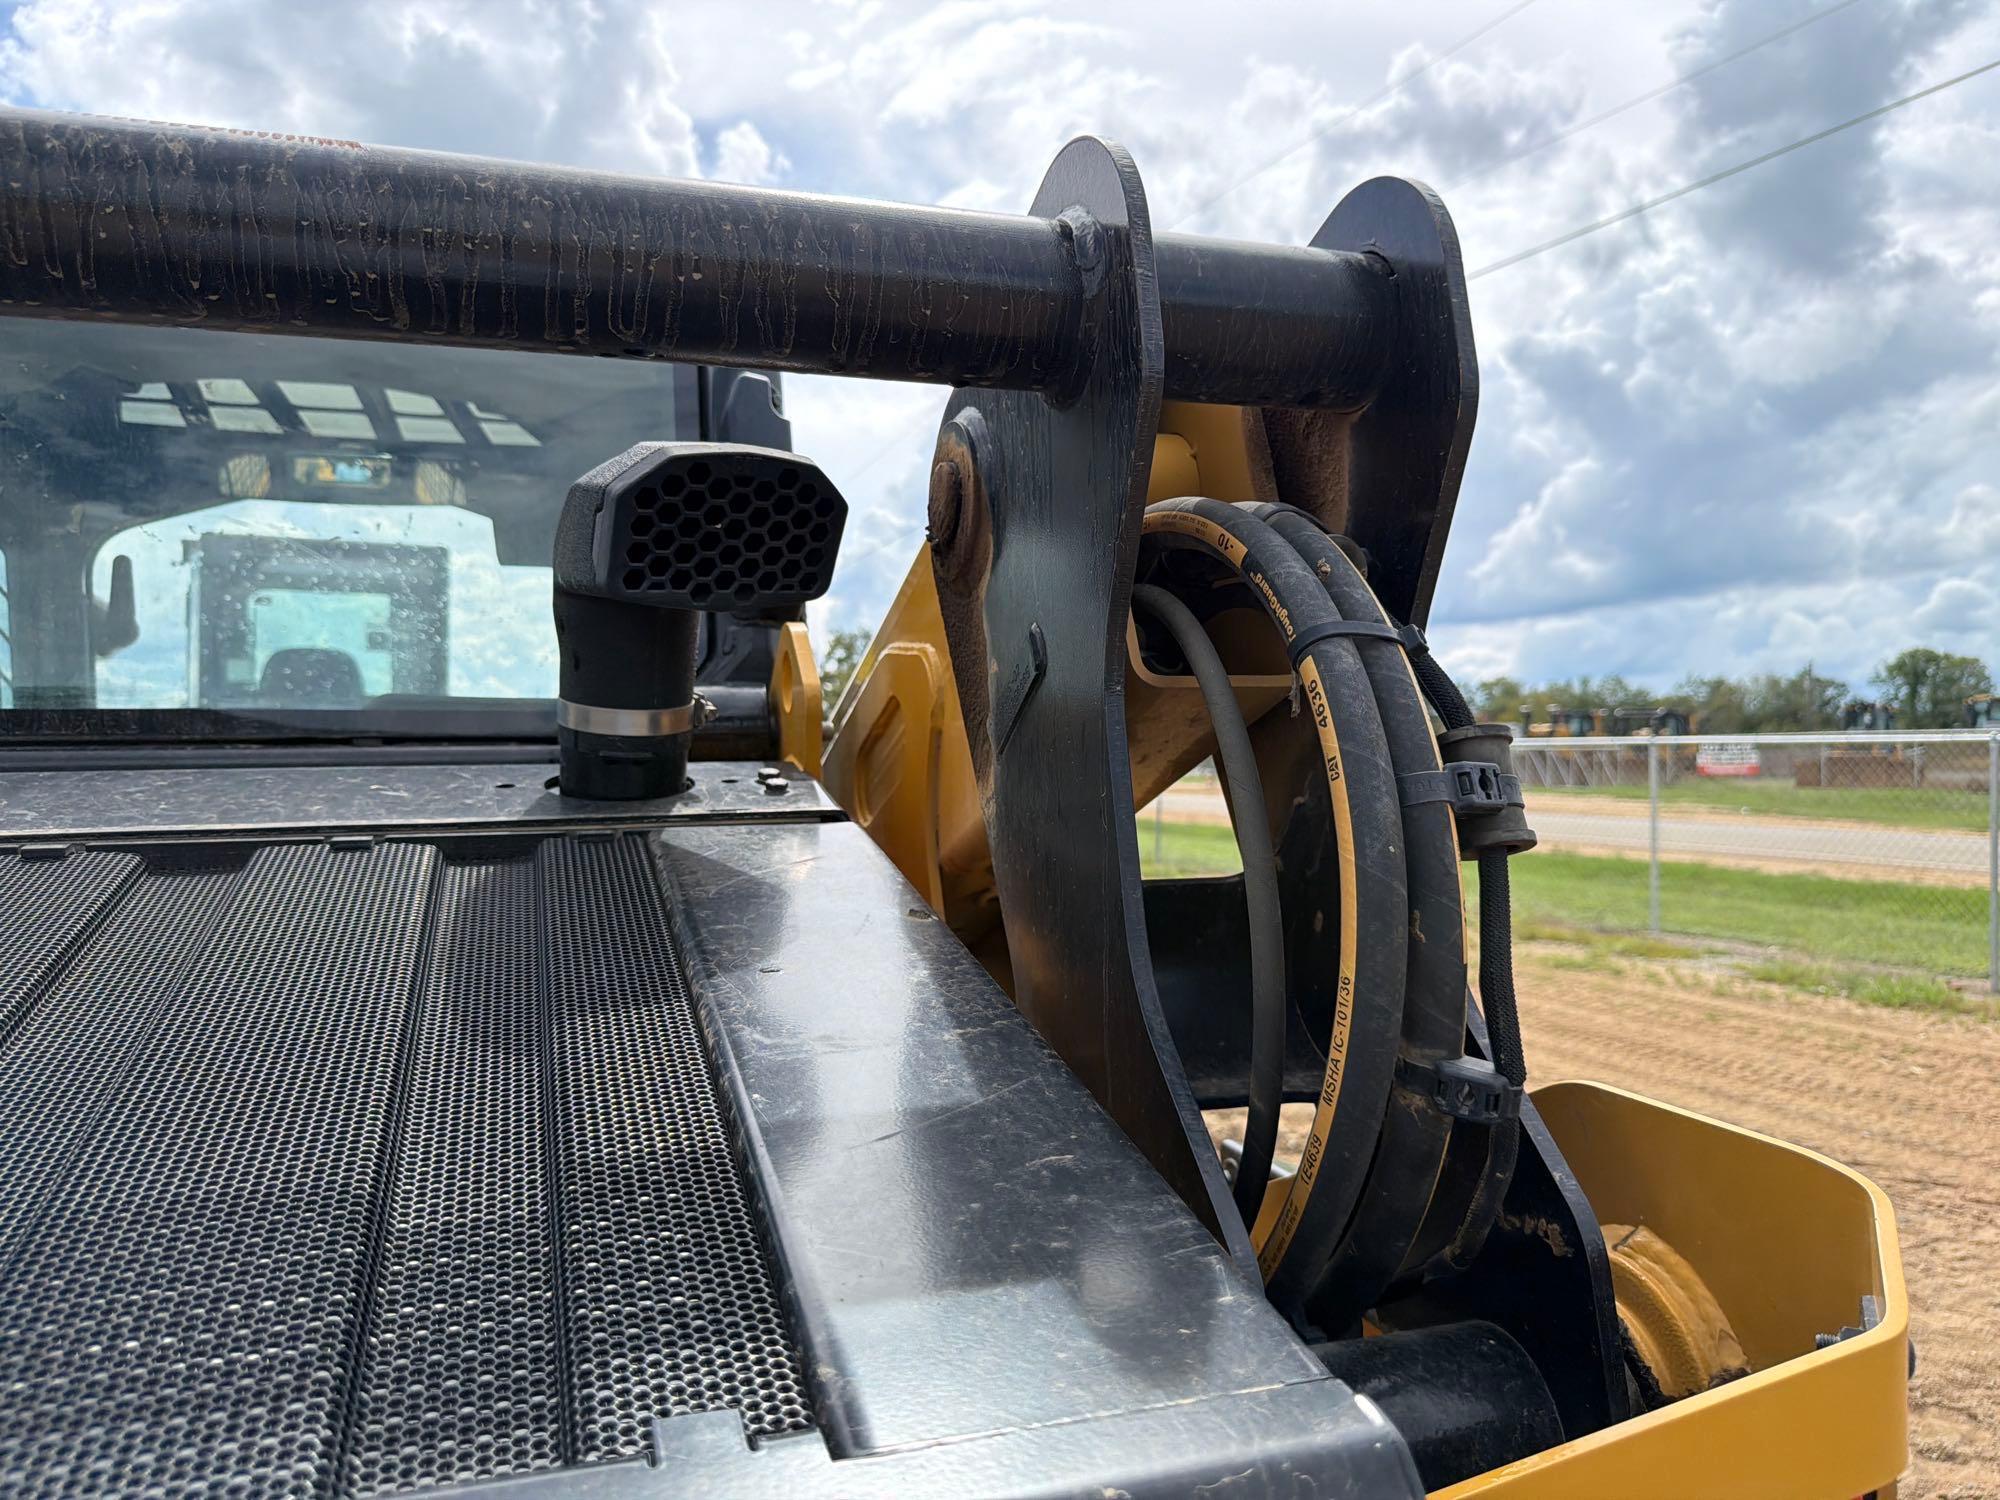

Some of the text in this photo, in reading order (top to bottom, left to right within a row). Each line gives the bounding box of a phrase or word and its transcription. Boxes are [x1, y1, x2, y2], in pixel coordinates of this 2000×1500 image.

[1308, 679, 1341, 782] CAT 4636
[1322, 1058, 1341, 1107] MSHA
[1332, 975, 1352, 1054] IC-101/36
